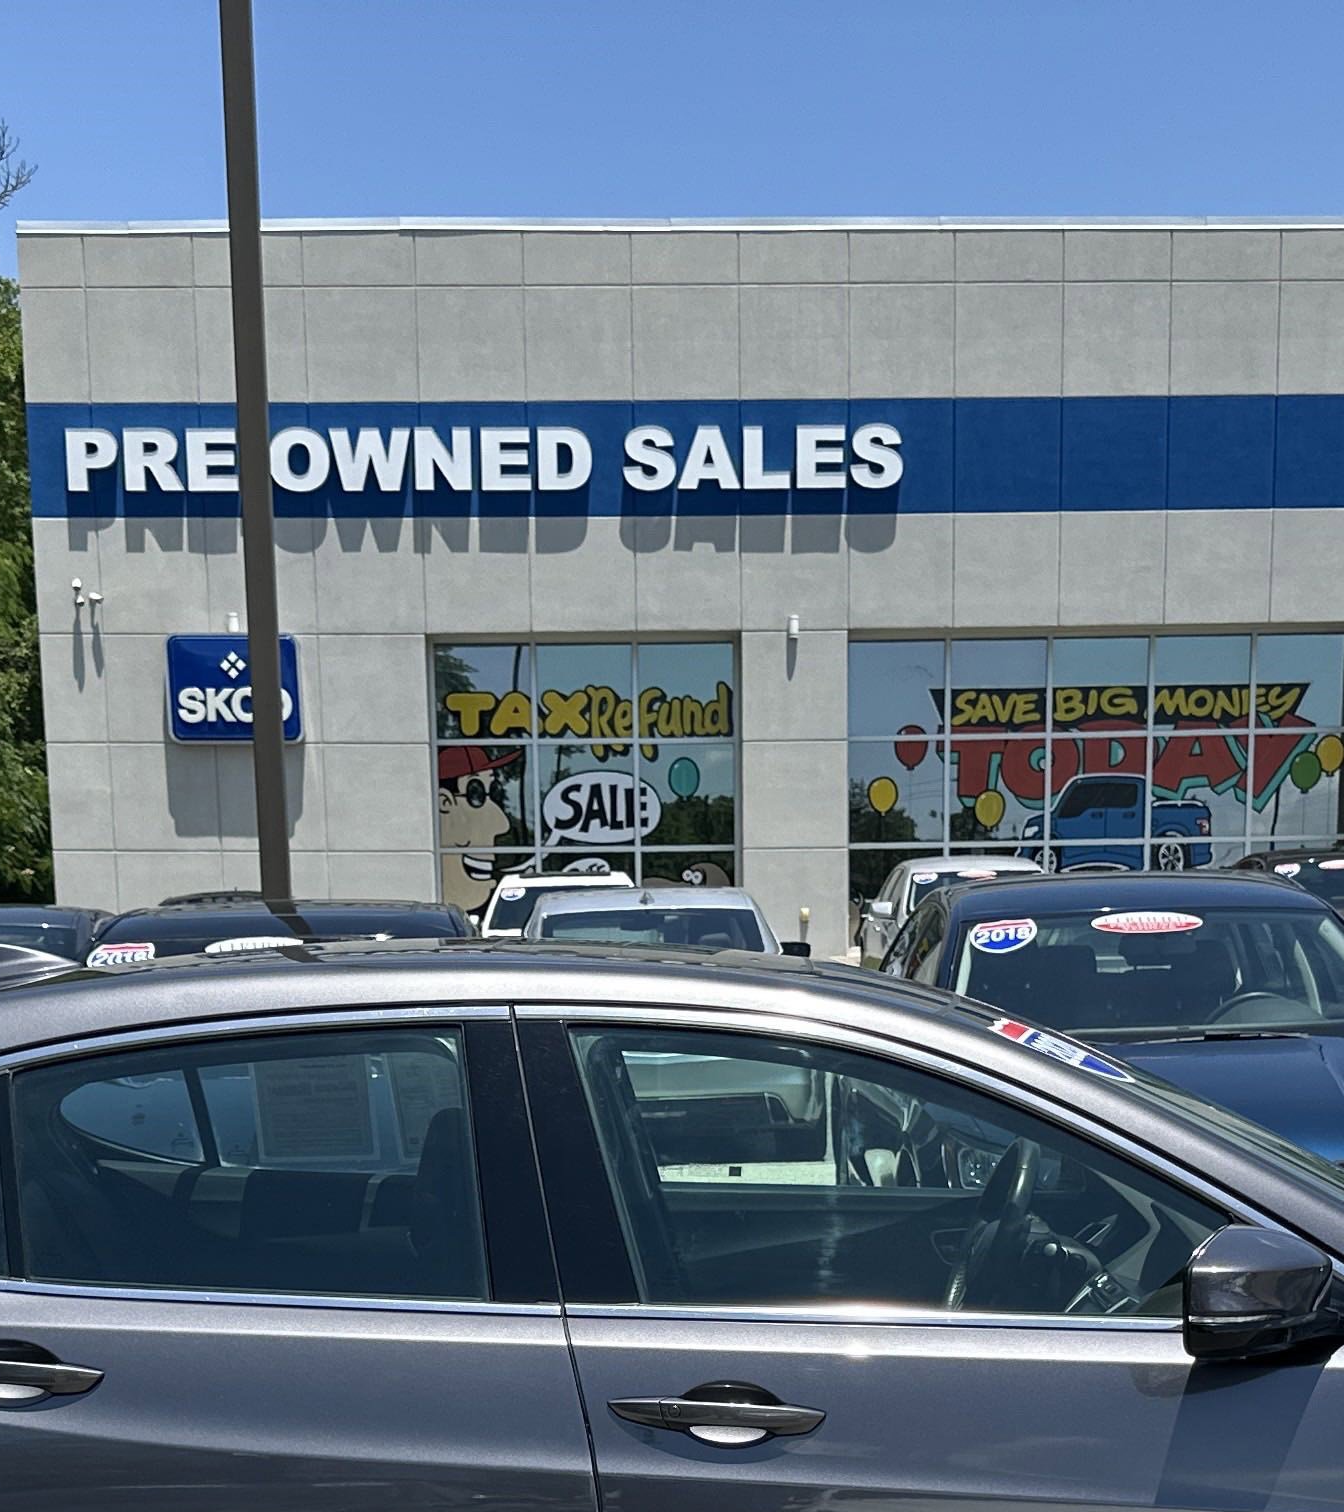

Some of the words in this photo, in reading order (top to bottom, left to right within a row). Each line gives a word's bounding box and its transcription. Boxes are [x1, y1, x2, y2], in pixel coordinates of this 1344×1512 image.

[622, 422, 904, 491] SALES
[445, 690, 590, 738] TAX
[585, 681, 733, 762] Refund
[950, 689, 1042, 727] SAVE
[1052, 686, 1138, 722] BIG
[1146, 685, 1301, 719] MONEY
[937, 712, 1318, 813] TODAY
[554, 782, 649, 833] SALE
[975, 925, 1031, 945] 2018
